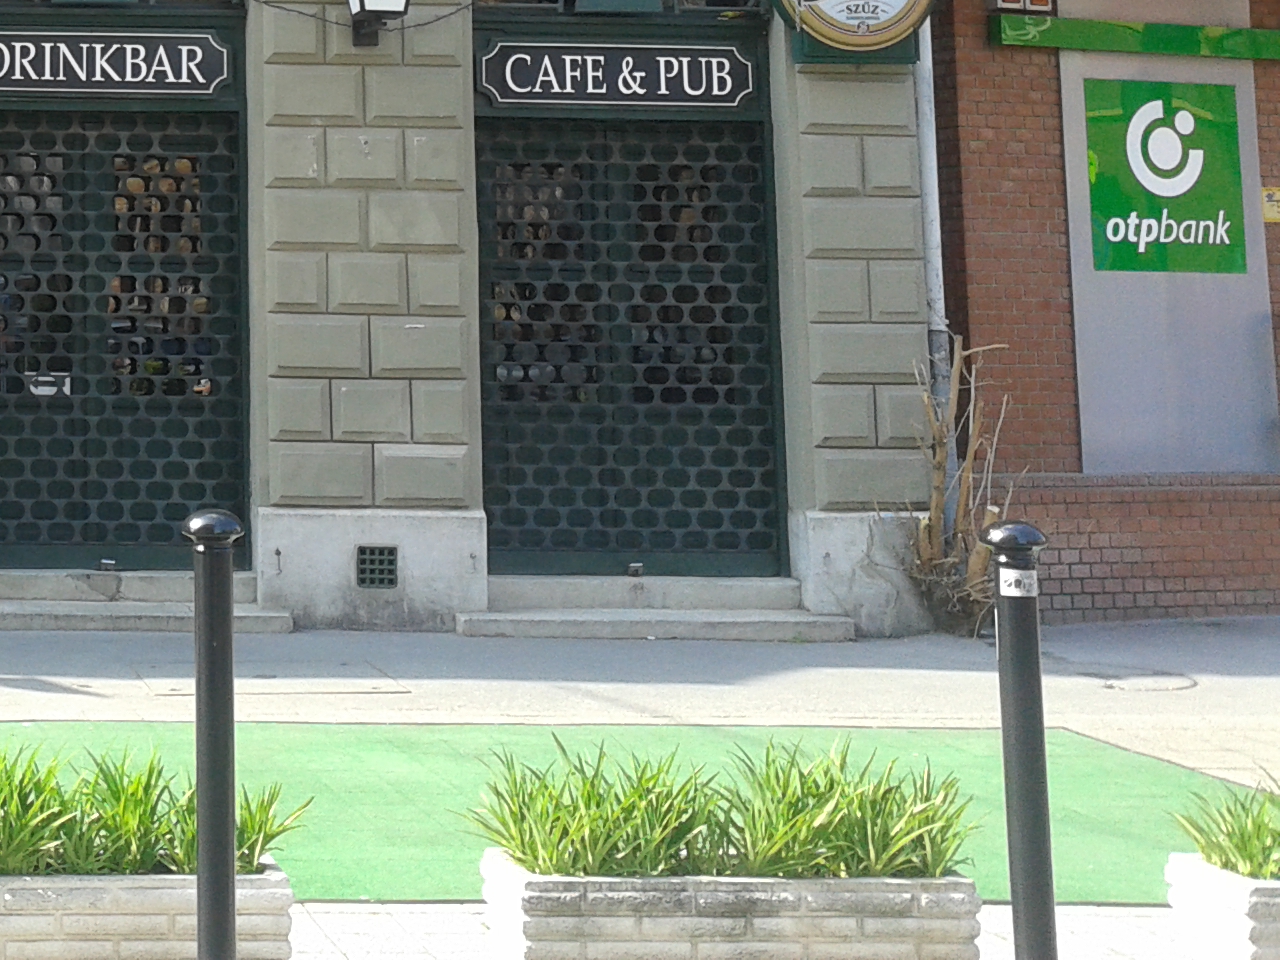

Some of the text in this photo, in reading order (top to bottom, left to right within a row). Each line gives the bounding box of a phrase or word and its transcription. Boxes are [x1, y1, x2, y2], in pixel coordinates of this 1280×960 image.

[505, 53, 733, 96] CAFE & PUB
